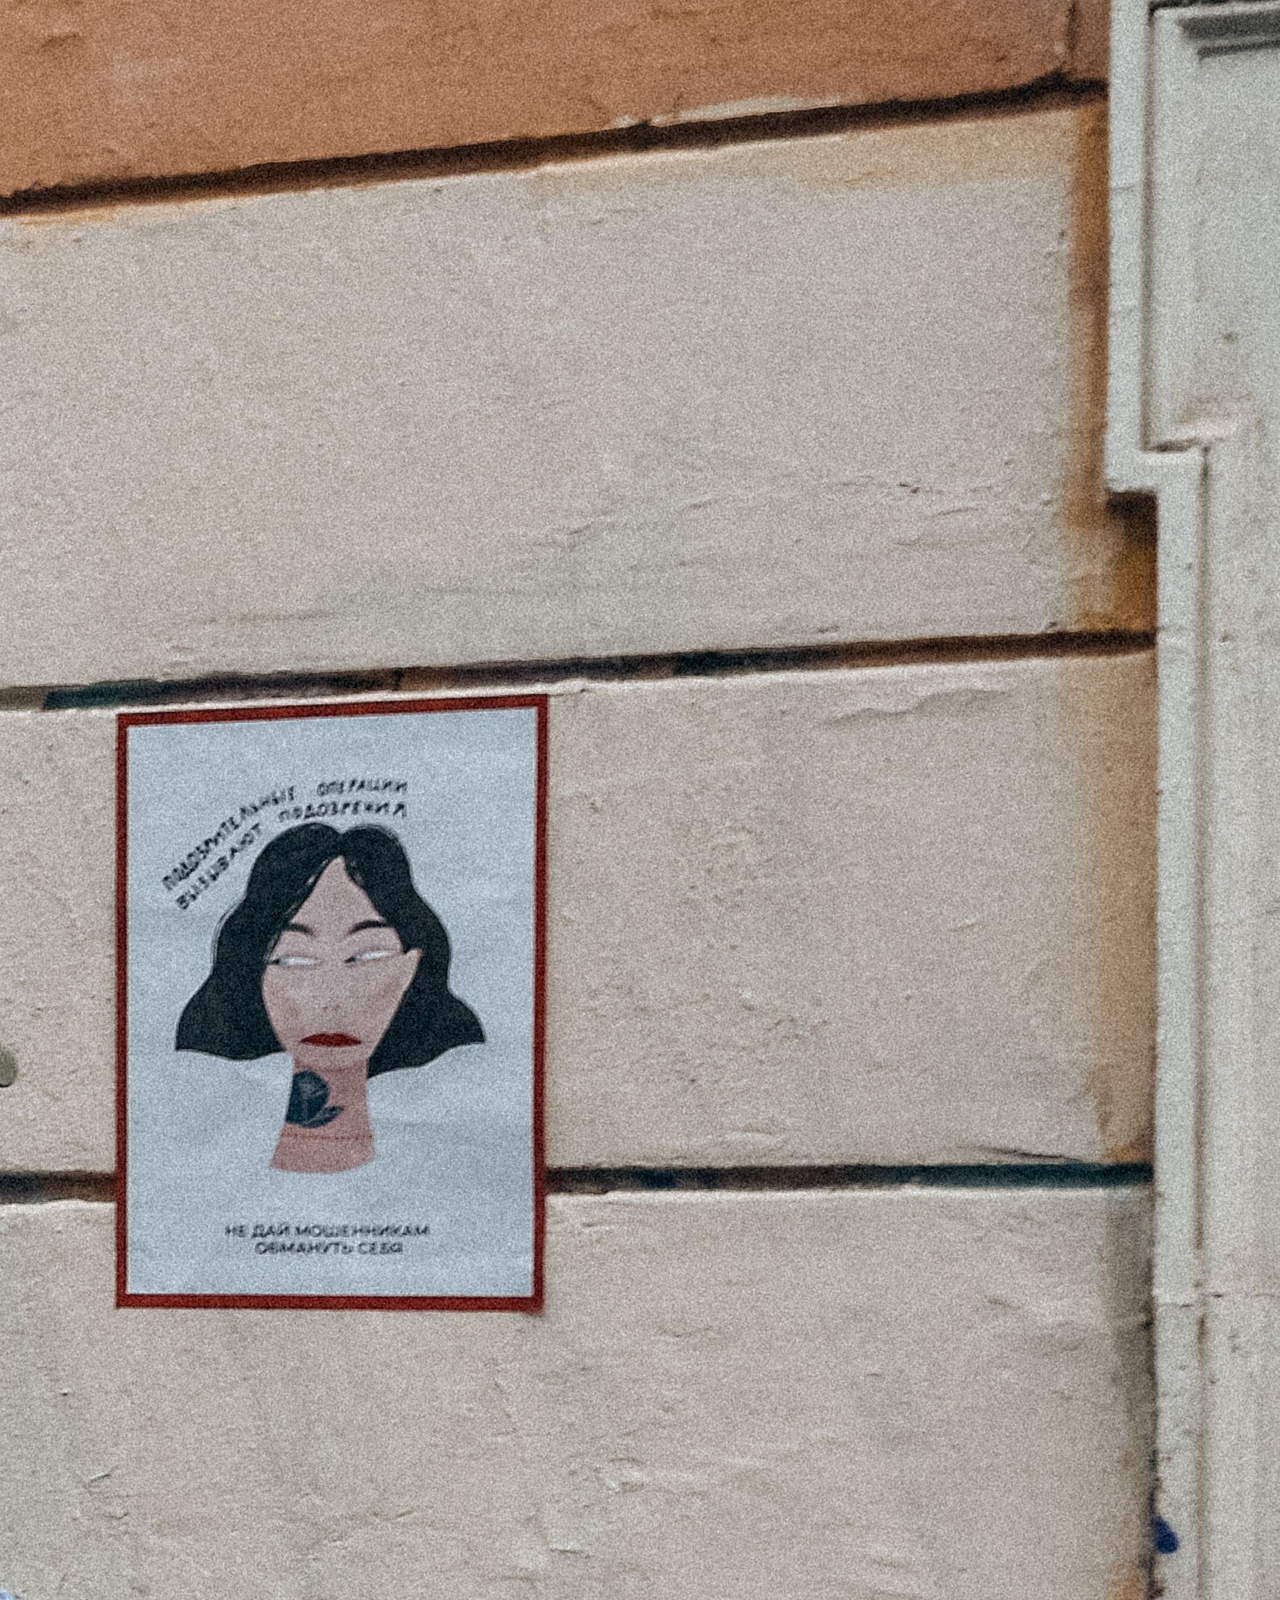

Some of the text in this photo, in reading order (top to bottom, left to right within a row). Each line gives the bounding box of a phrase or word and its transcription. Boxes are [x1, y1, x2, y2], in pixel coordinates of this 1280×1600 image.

[162, 779, 408, 891] ПОДОЗРИТЕЛЬНЫЕ ОПЕРАЦИИ
[176, 800, 408, 910] ВЫЗЫВАЮТ ПОДОЗРЕНИЯ
[224, 1221, 431, 1239] НЕ ДАЙ МОШЕННИКАМ
[254, 1241, 404, 1255] ОБМАНУТЬ СЕБЯ
